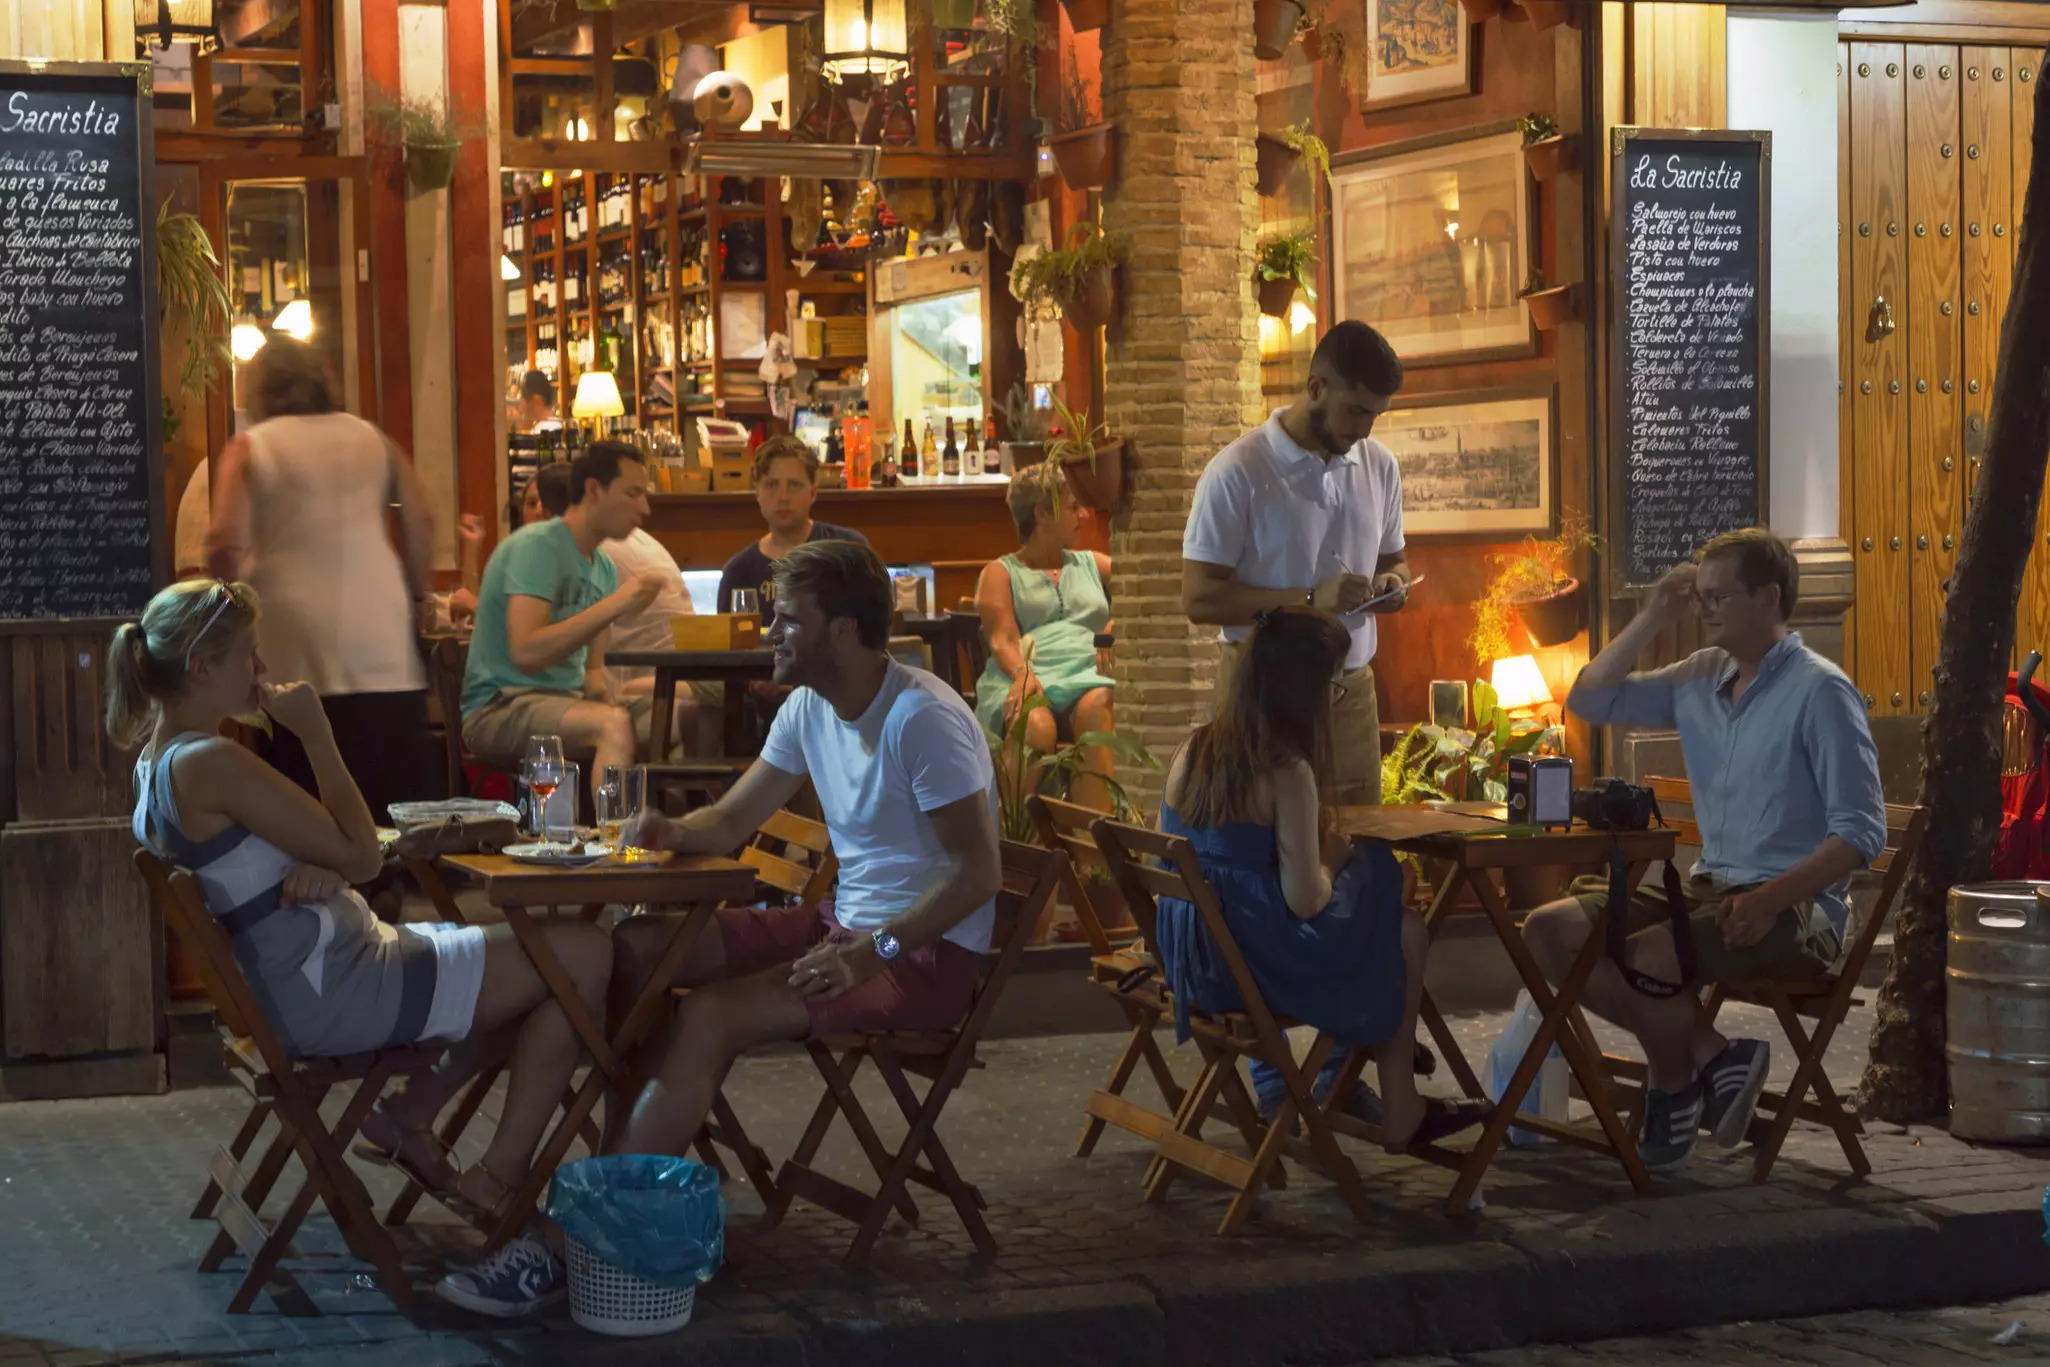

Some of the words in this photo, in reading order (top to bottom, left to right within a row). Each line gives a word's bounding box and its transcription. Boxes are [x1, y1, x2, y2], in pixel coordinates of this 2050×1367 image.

[0, 91, 120, 135] Sacristia
[65, 150, 110, 173] Rusa
[1630, 154, 1657, 189] La
[1661, 154, 1742, 189] Sacristia
[3, 209, 20, 230] de
[1631, 201, 1687, 224] Salmorejo
[1707, 202, 1737, 220] huevo
[1631, 218, 1674, 235] Paella
[1677, 219, 1691, 235] de
[1677, 235, 1691, 251] de
[1629, 251, 1663, 267] Pisto
[1687, 250, 1721, 267] huevo
[1674, 299, 1689, 312] de
[1691, 297, 1746, 318] Alcachofa
[1680, 313, 1695, 328] de
[1689, 328, 1704, 344] de
[1680, 376, 1696, 390] de
[1664, 466, 1679, 482] de
